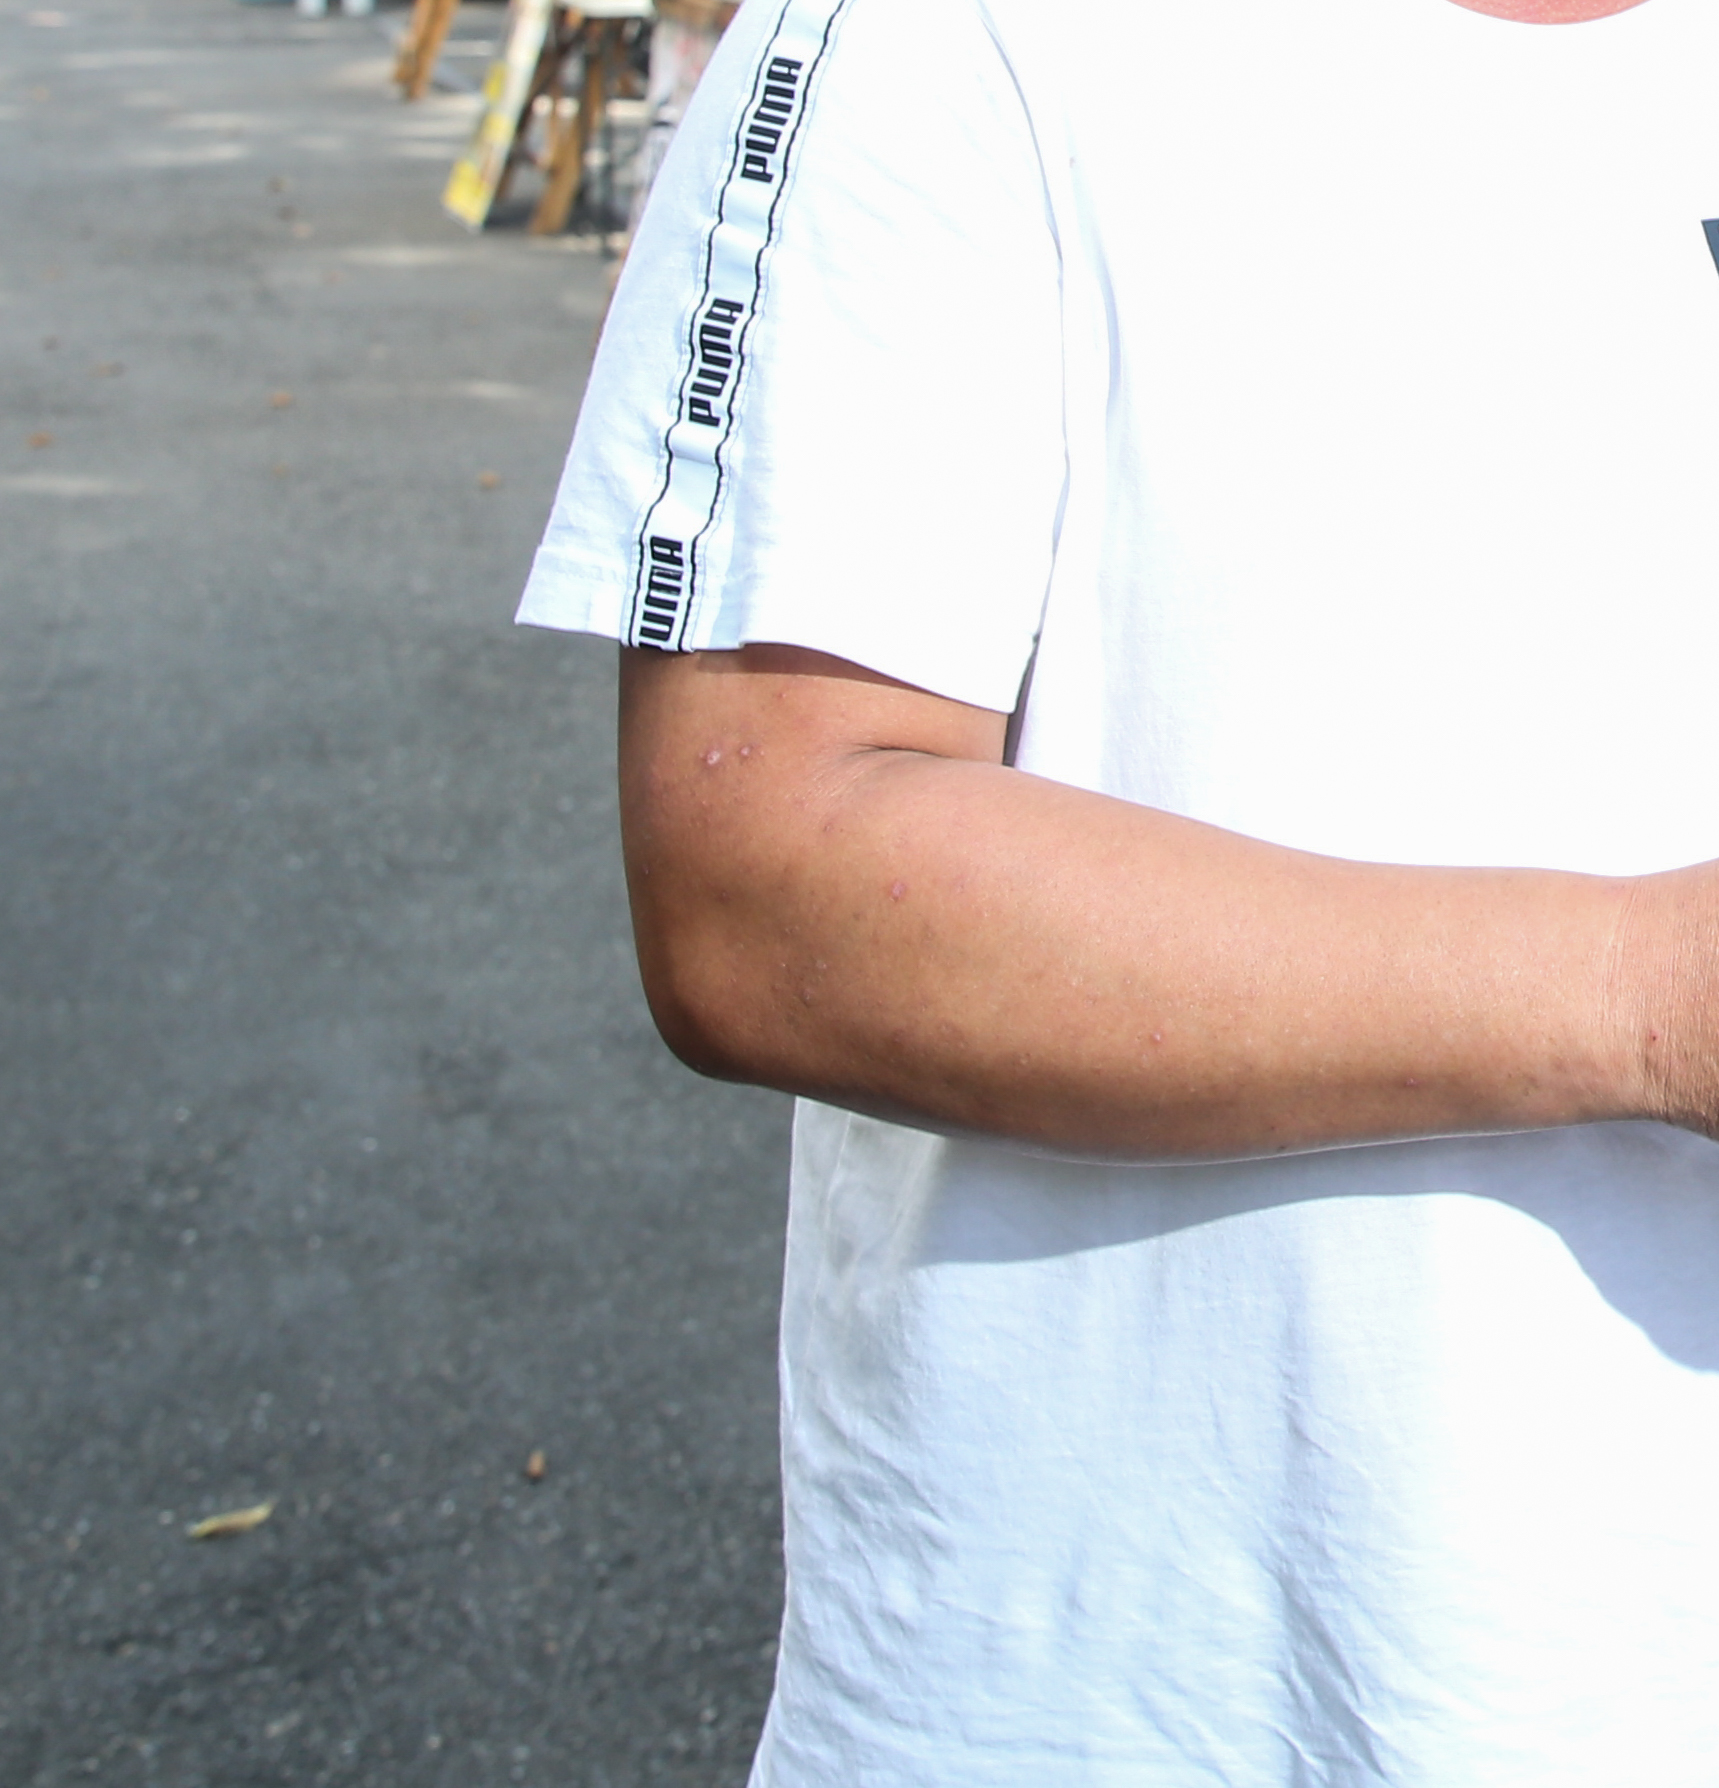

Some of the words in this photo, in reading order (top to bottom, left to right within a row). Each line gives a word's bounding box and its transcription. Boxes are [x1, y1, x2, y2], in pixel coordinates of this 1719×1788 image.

[740, 55, 804, 184] PUMA
[688, 297, 746, 428] PUMA
[638, 535, 685, 651] UMA
